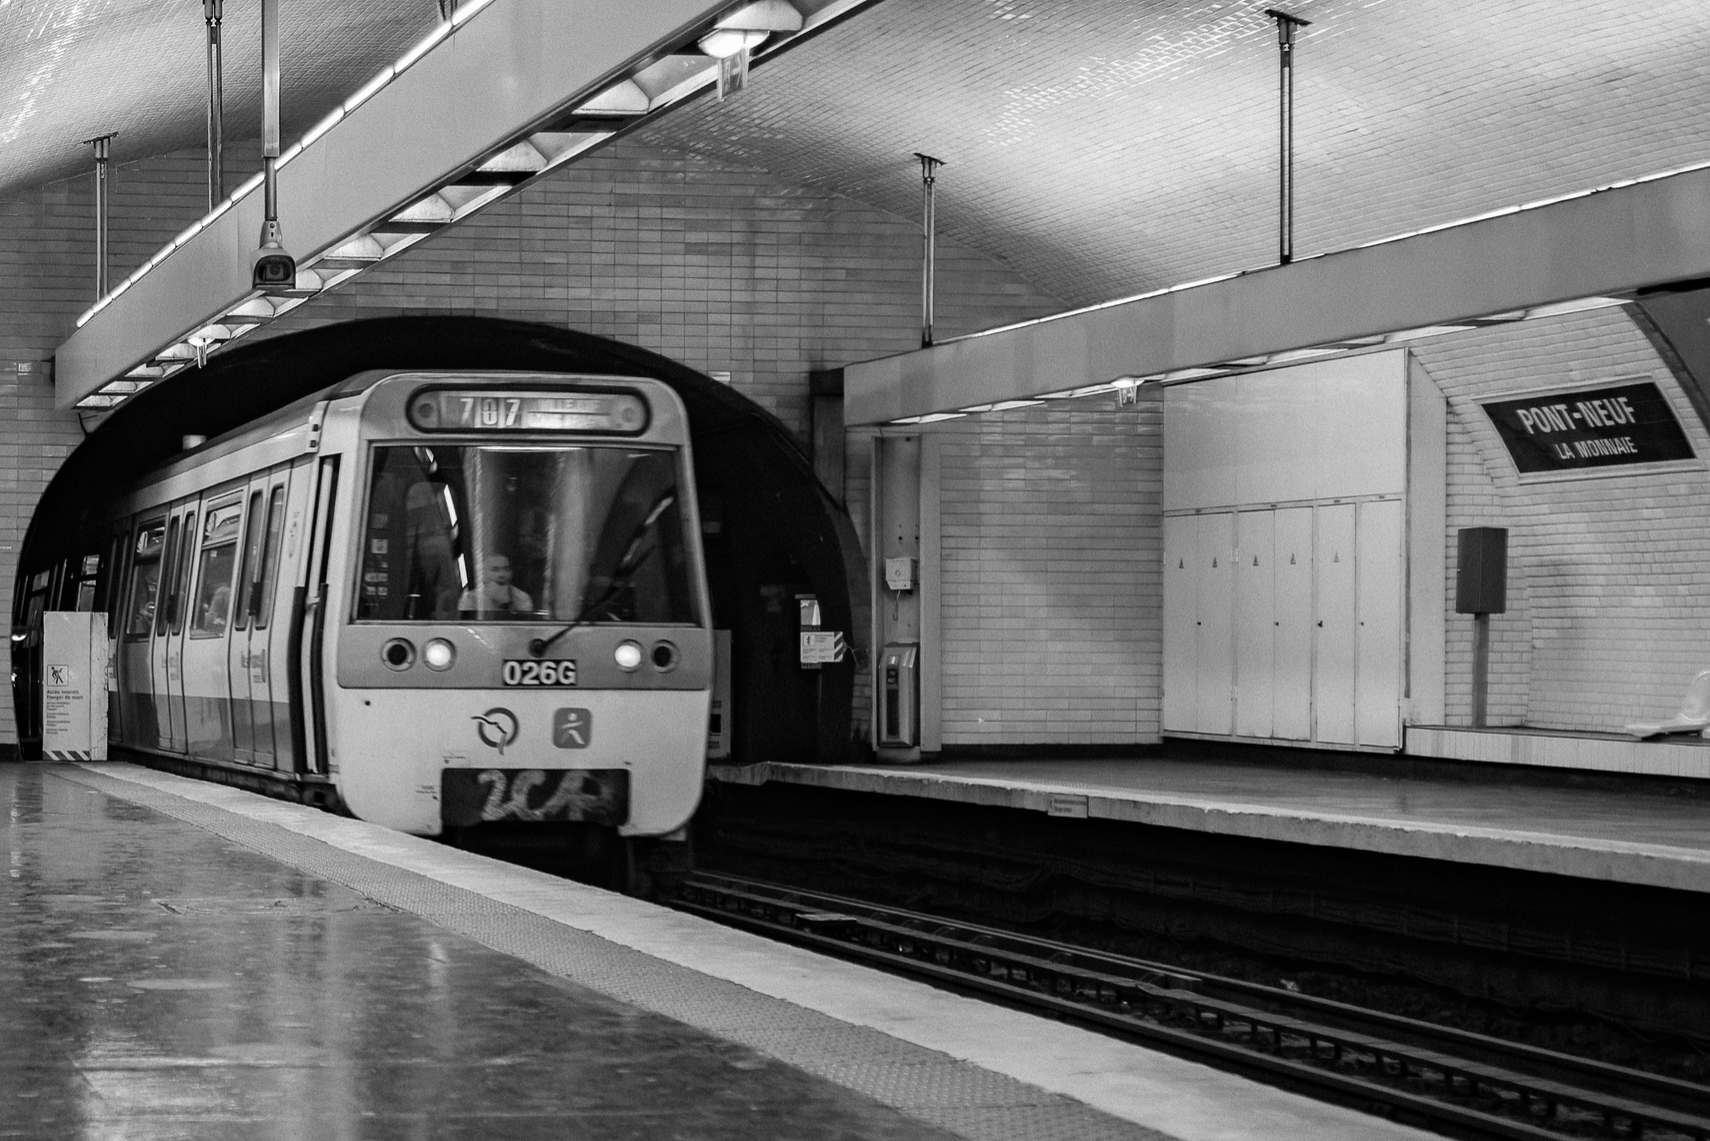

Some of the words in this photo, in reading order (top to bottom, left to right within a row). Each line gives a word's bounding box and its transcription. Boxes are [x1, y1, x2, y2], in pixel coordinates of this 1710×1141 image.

[1515, 397, 1636, 434] PONT-NEUF
[1555, 442, 1576, 459] LA
[1574, 436, 1638, 459] MONNAIE
[502, 661, 576, 685] 026G
